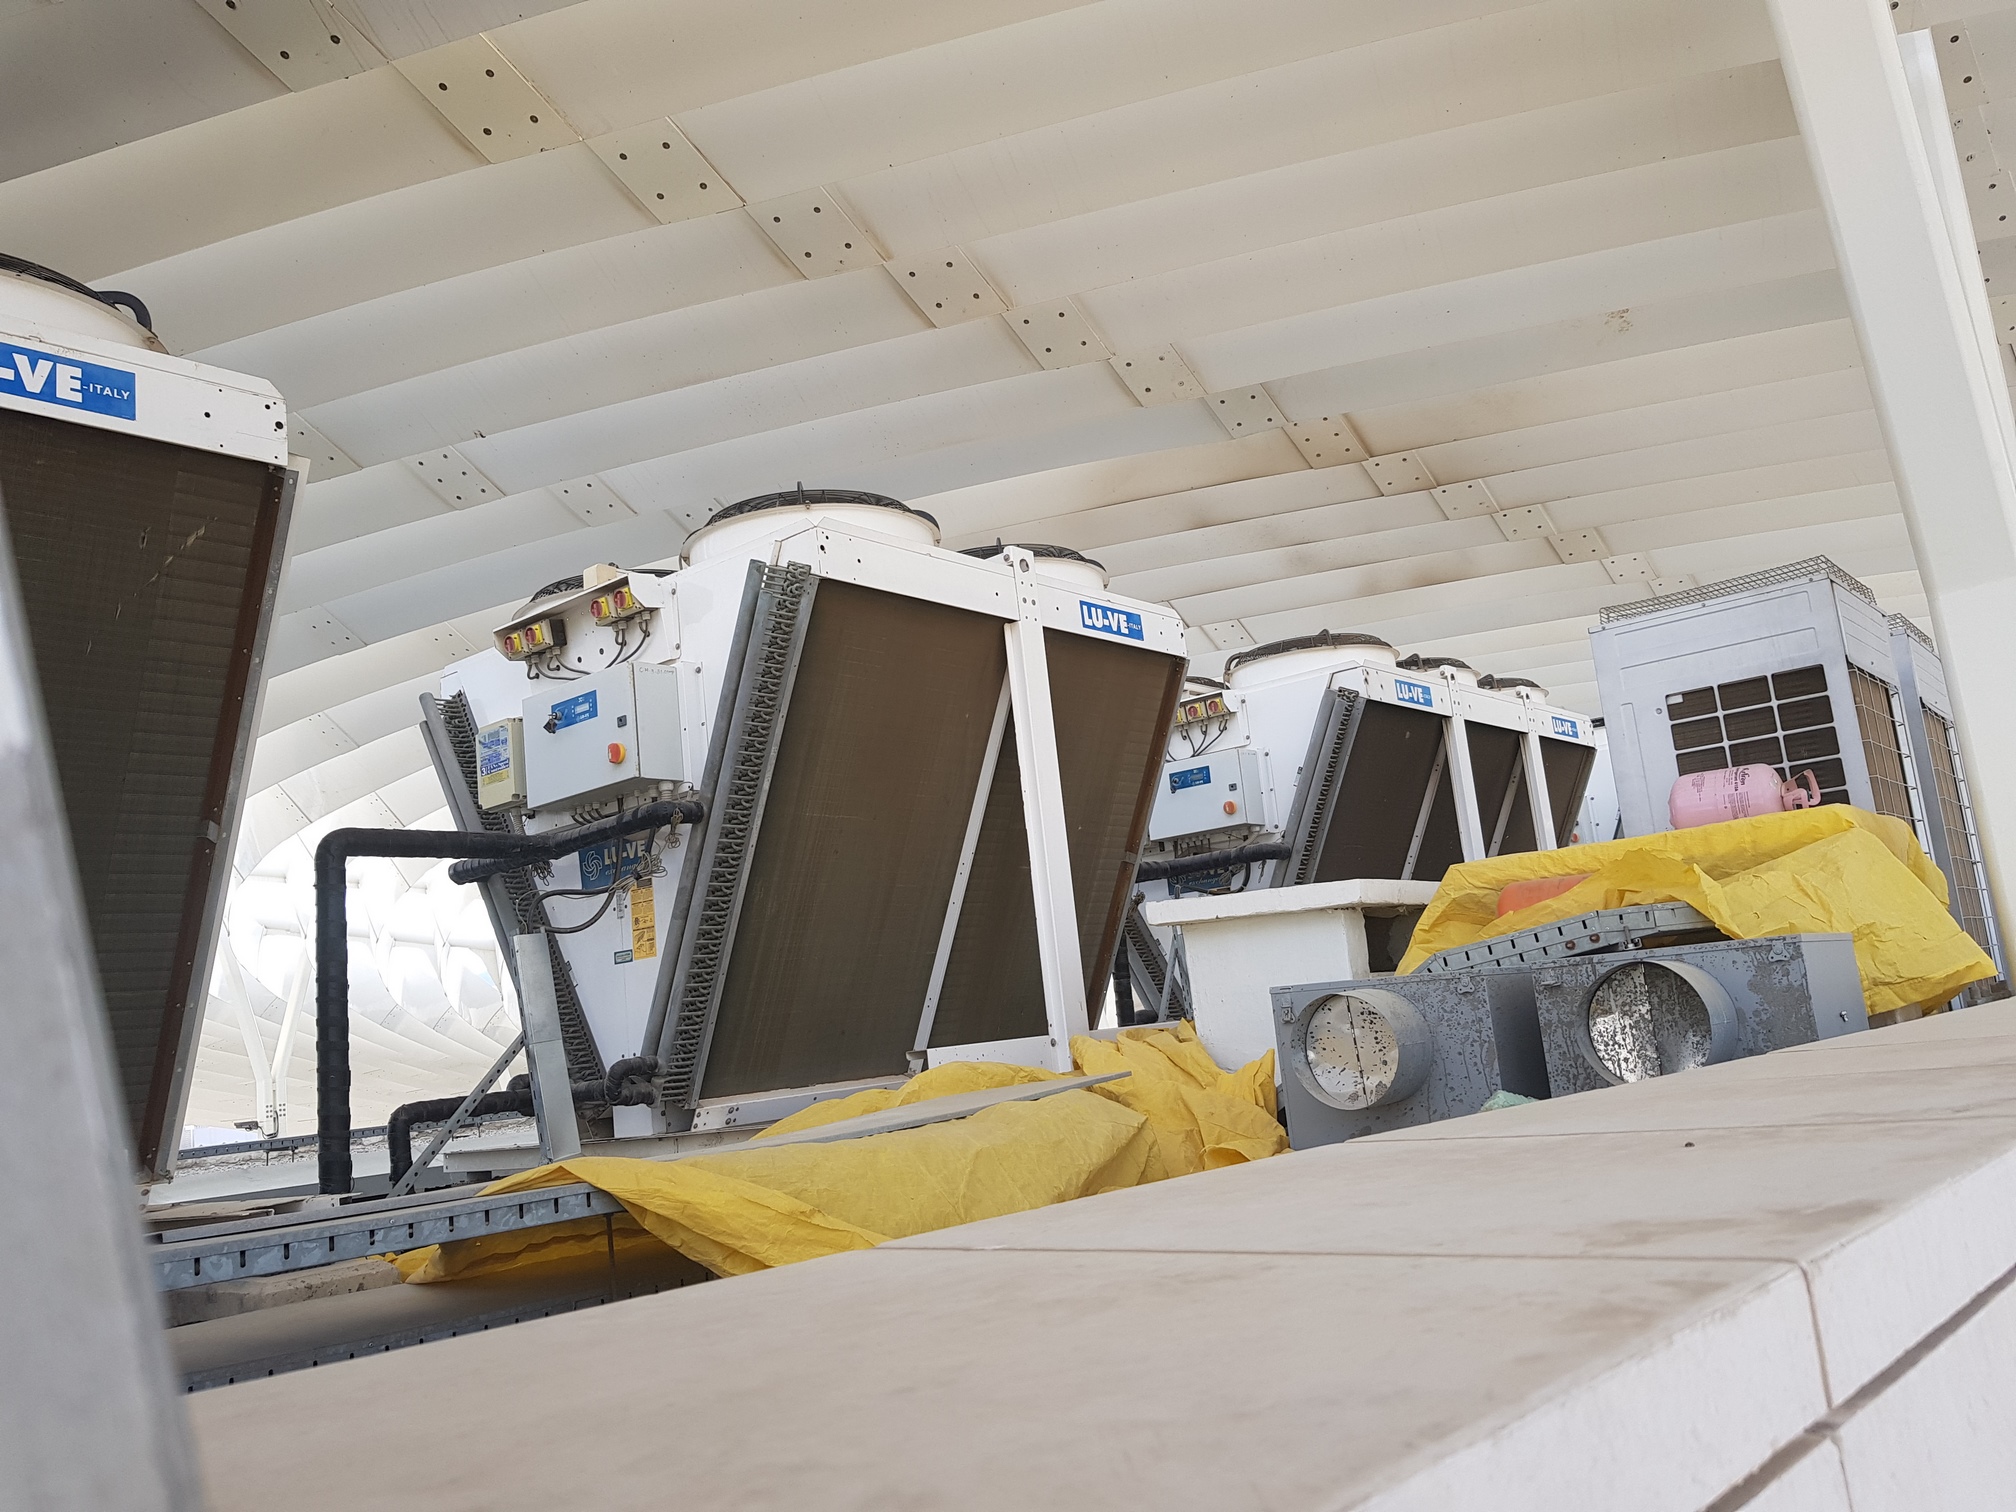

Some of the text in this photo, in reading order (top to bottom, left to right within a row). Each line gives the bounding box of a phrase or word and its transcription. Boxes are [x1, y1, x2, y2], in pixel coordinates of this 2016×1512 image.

[1082, 604, 1129, 634] LU-VE
[1396, 682, 1424, 703] LU-VE
[1552, 718, 1573, 736] LU-VE
